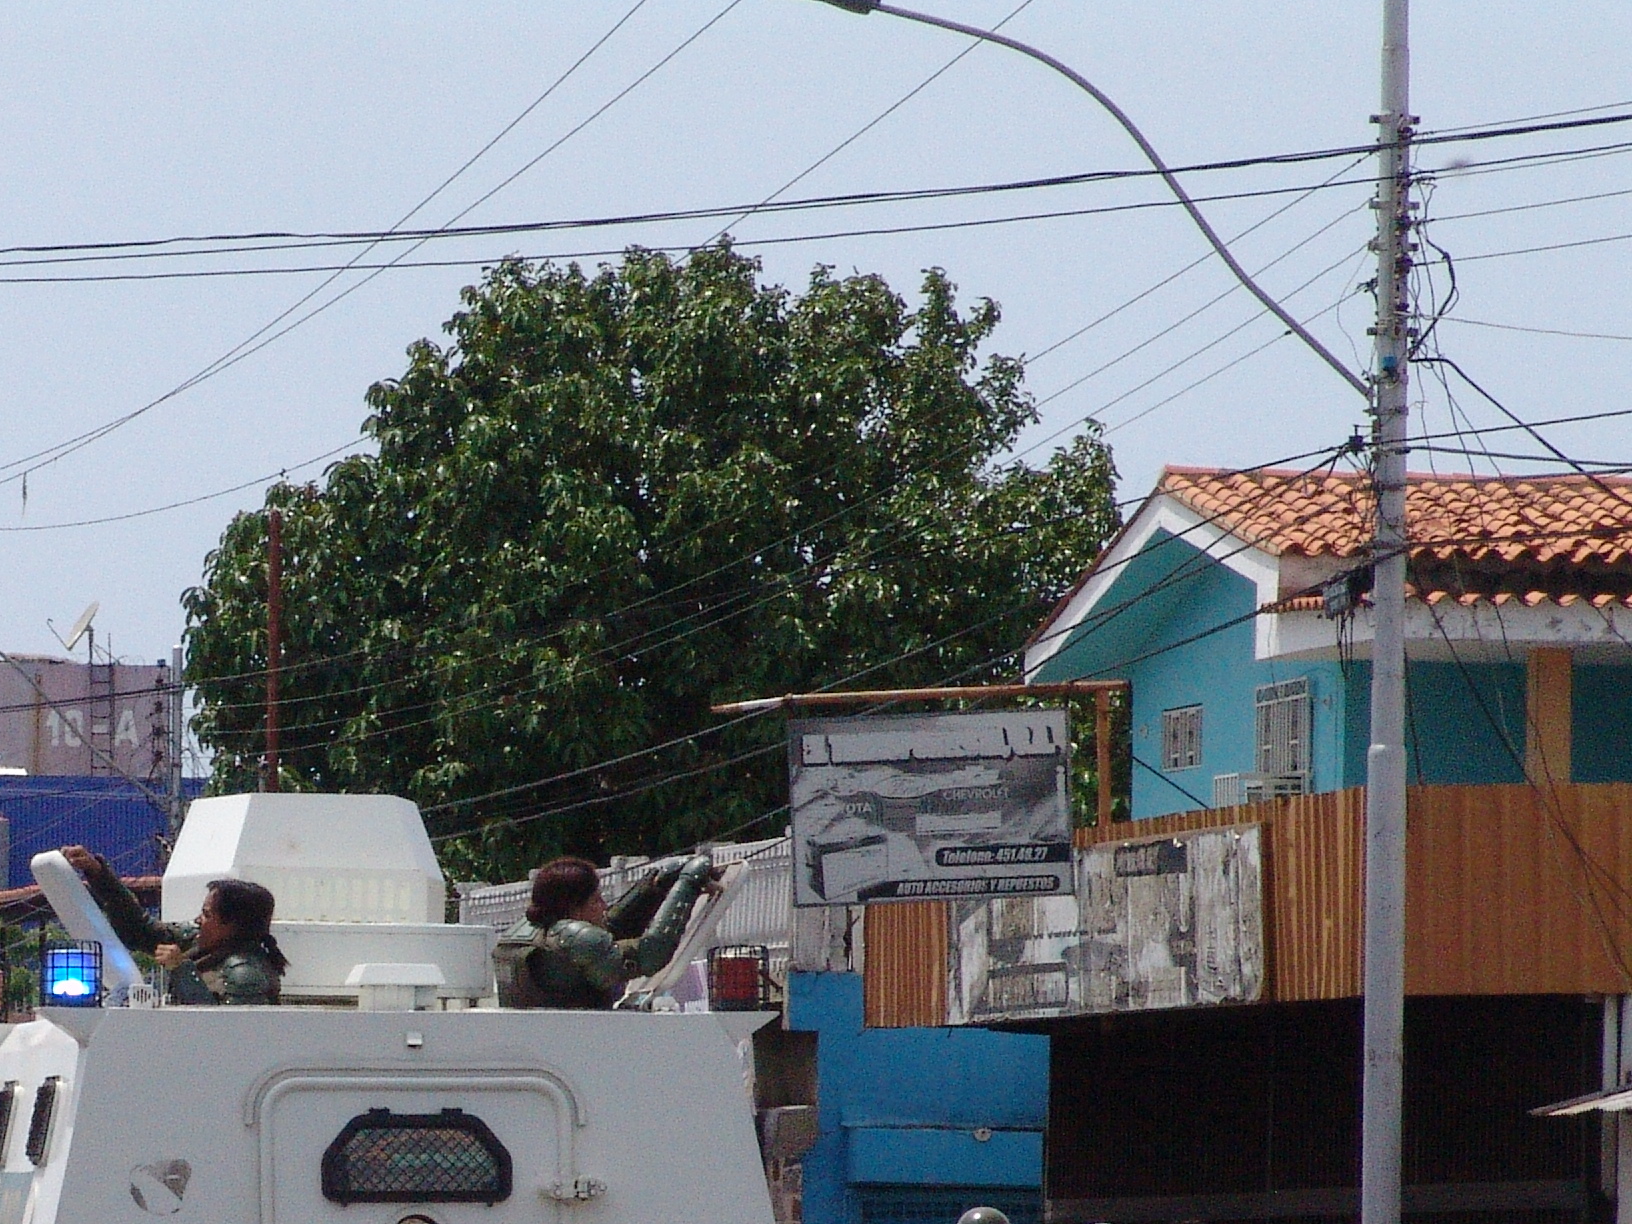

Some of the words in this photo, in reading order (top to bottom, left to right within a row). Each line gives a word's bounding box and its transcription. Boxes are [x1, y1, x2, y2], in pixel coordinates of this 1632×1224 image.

[897, 882, 923, 895] AUTO
[925, 878, 985, 893] ACCESORIOS
[989, 879, 998, 891] Y
